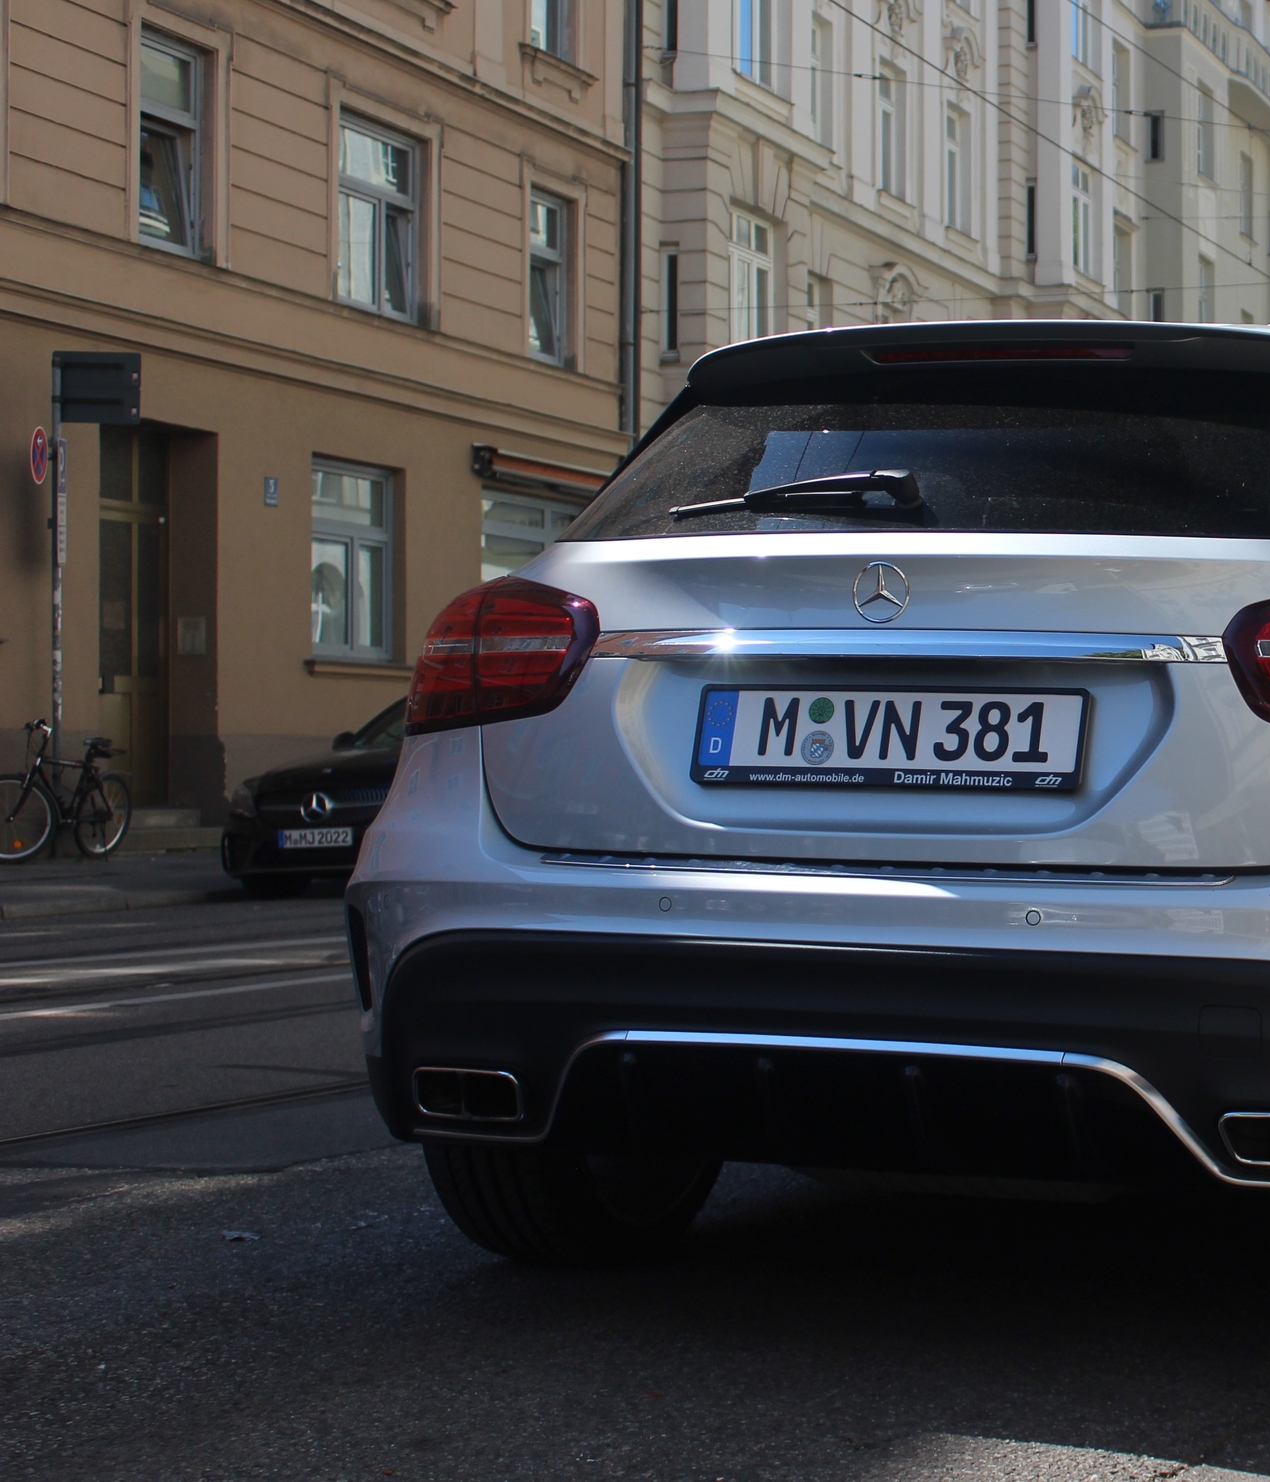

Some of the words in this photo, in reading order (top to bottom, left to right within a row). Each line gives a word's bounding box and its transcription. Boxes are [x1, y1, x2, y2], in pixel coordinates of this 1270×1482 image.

[758, 697, 800, 756] M
[844, 700, 922, 760] VN
[933, 701, 1048, 763] 381
[709, 737, 722, 754] D
[749, 772, 864, 784] www.dm-automobile.de
[894, 771, 937, 785] Damir
[940, 773, 1013, 787] Mahmuzic
[317, 830, 349, 845] 2022
